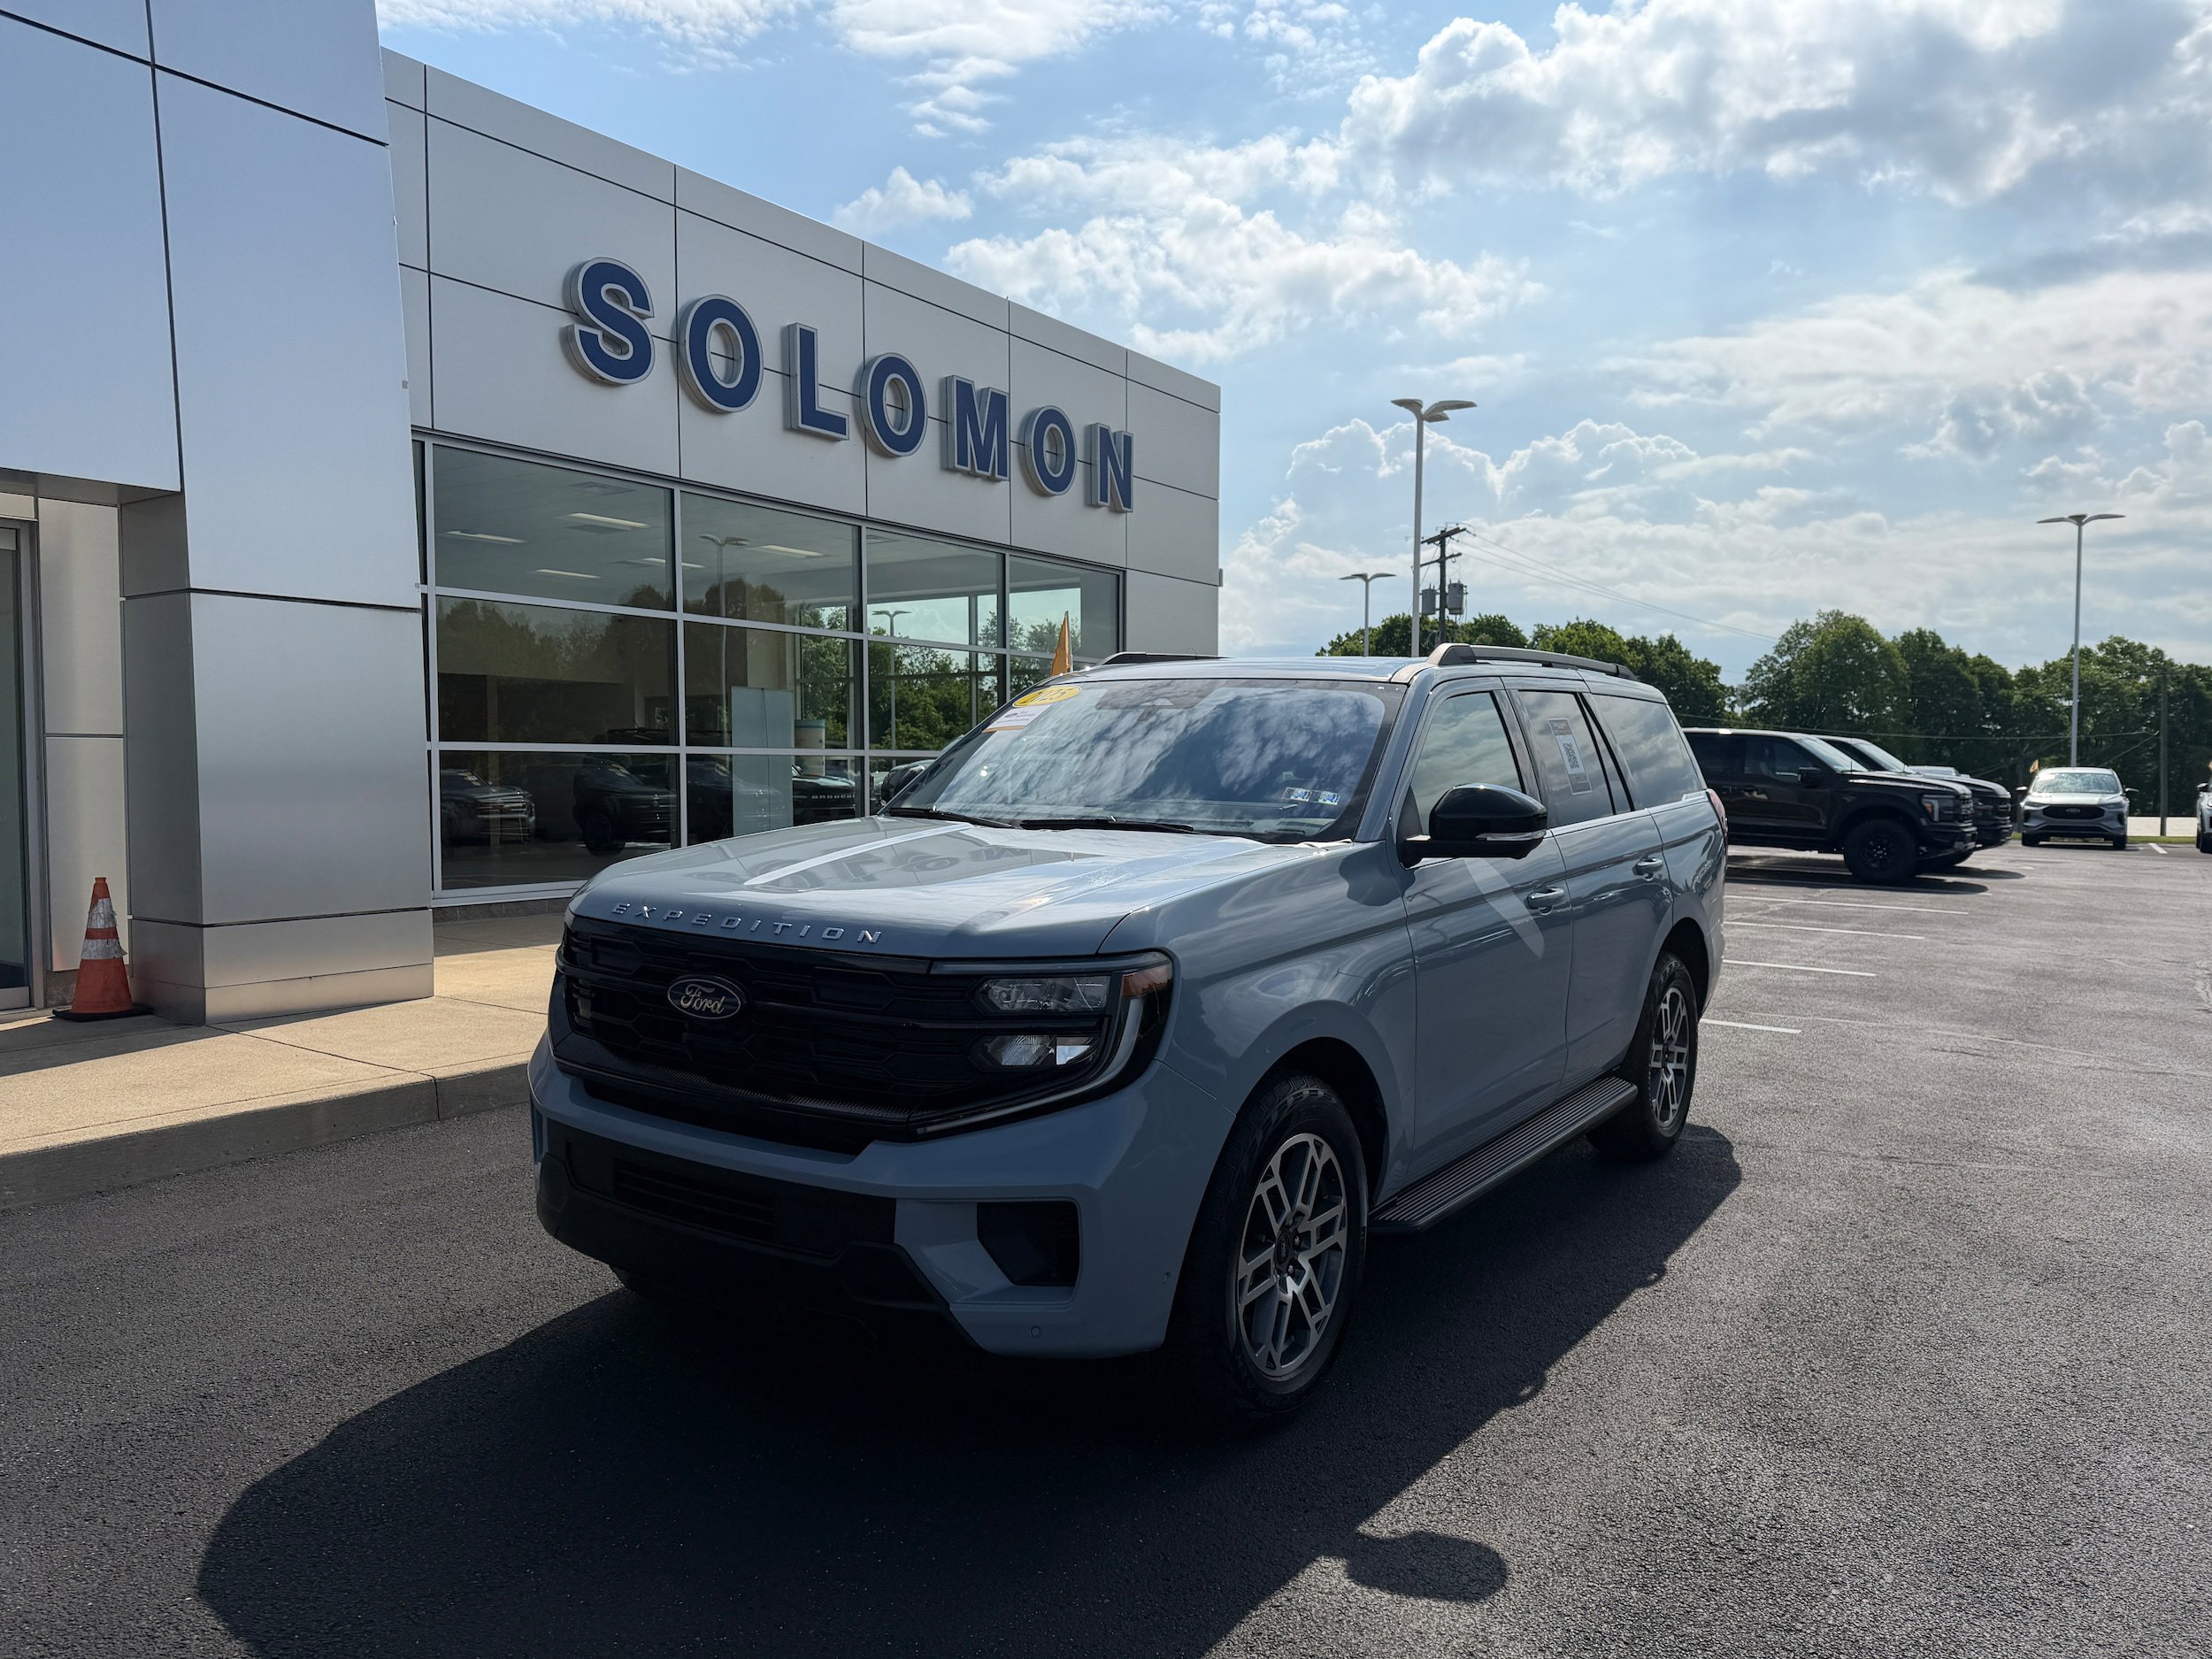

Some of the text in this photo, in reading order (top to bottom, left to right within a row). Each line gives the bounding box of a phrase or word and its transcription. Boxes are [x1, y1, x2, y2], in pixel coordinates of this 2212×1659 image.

[567, 257, 1133, 512] SOLOMON
[611, 902, 882, 944] EXPEDITION
[680, 983, 726, 1015] Ford
